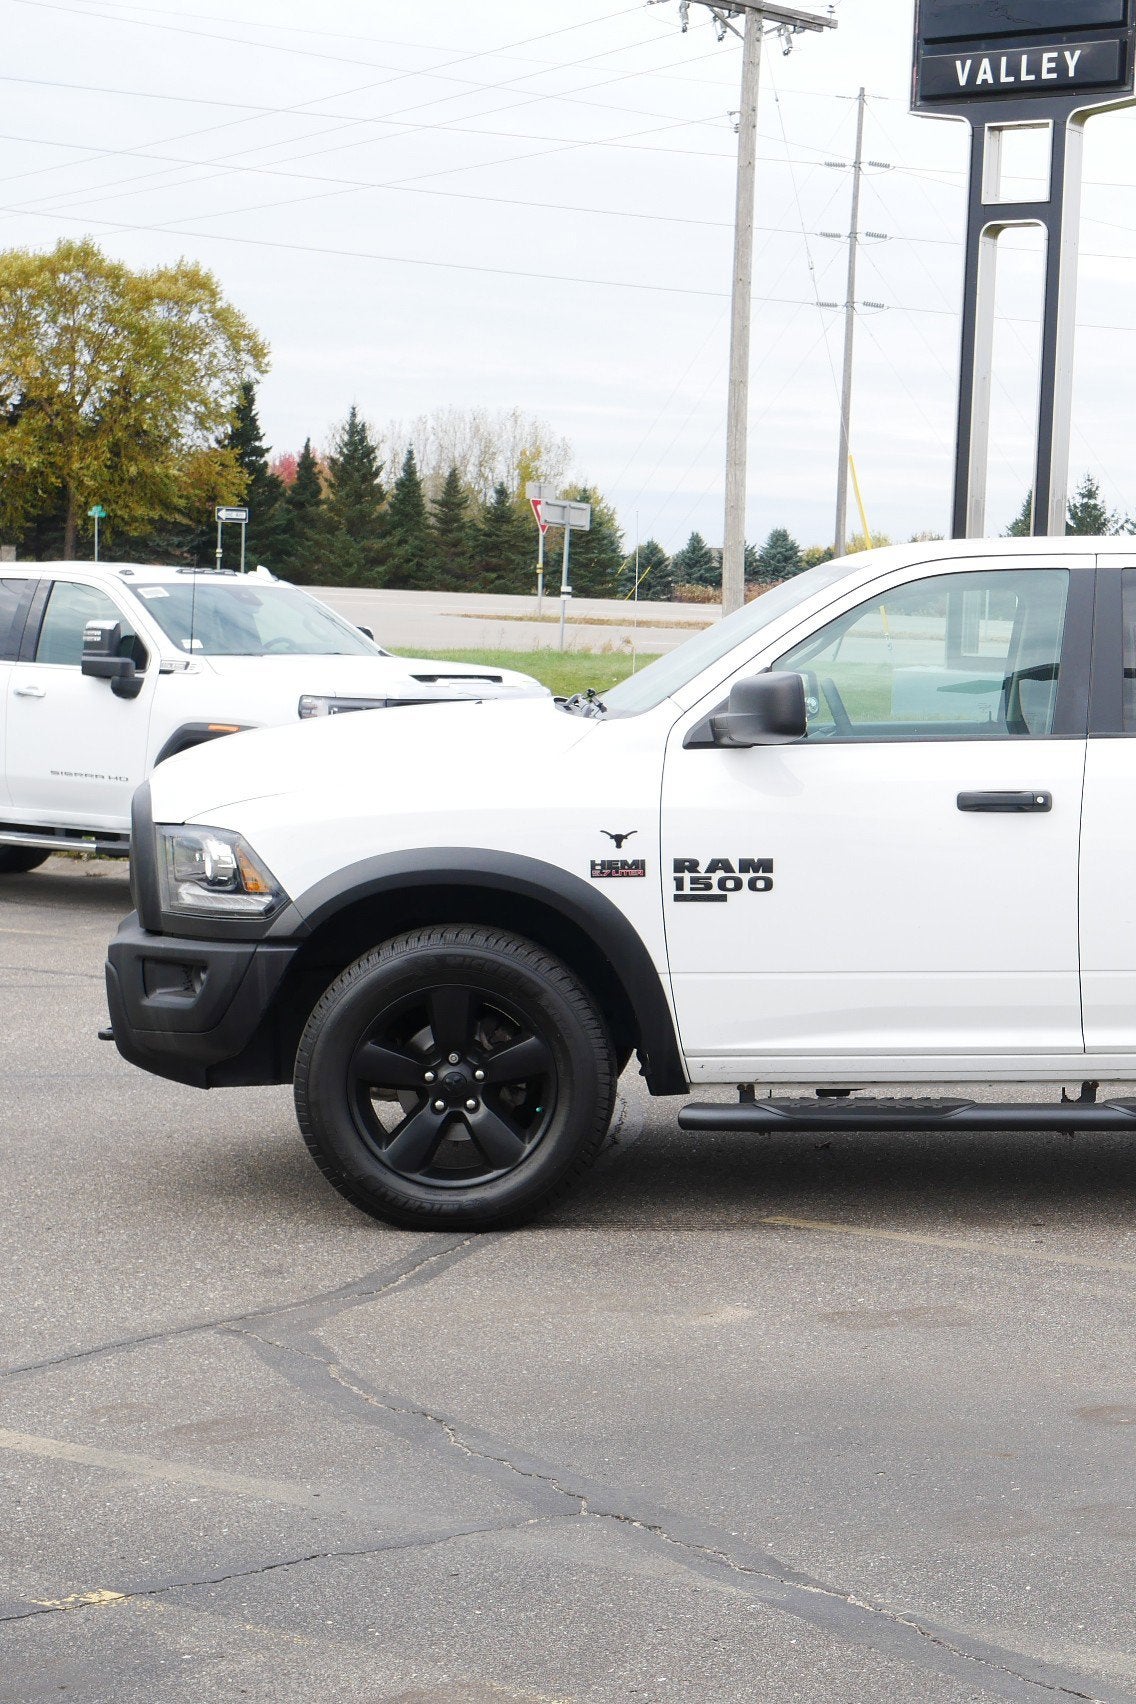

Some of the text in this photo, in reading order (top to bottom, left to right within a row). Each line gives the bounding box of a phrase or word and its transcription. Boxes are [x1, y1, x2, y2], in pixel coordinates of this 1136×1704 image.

[955, 50, 1082, 86] VALLEY
[590, 859, 646, 870] HEMI
[673, 857, 774, 874] RAM
[673, 875, 774, 892] 1500
